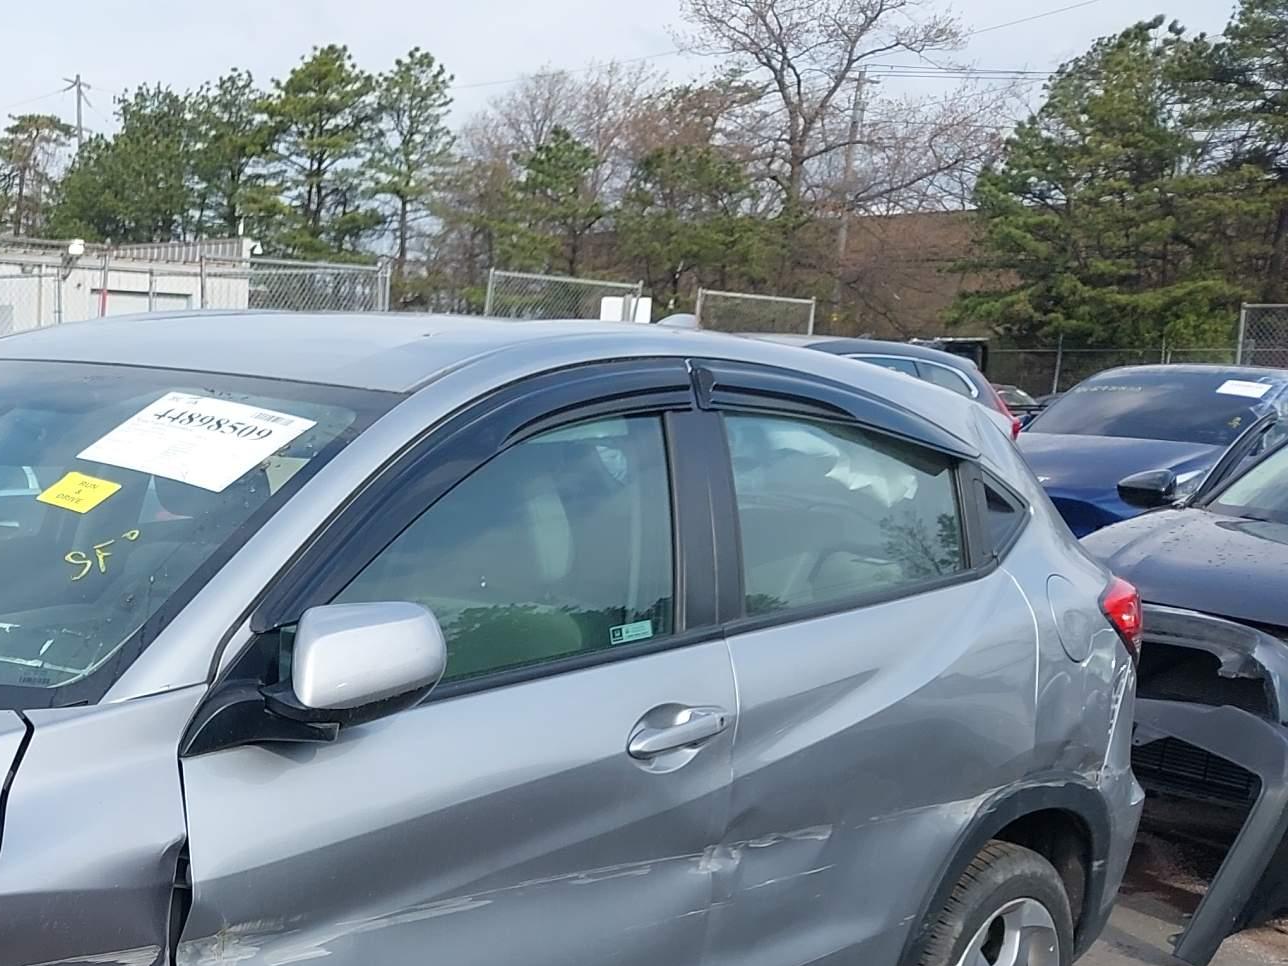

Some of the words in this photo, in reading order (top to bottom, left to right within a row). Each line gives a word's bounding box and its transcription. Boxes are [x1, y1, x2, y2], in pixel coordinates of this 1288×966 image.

[153, 408, 273, 441] 44898509
[78, 480, 99, 489] RUN
[55, 493, 84, 504] DRIVE
